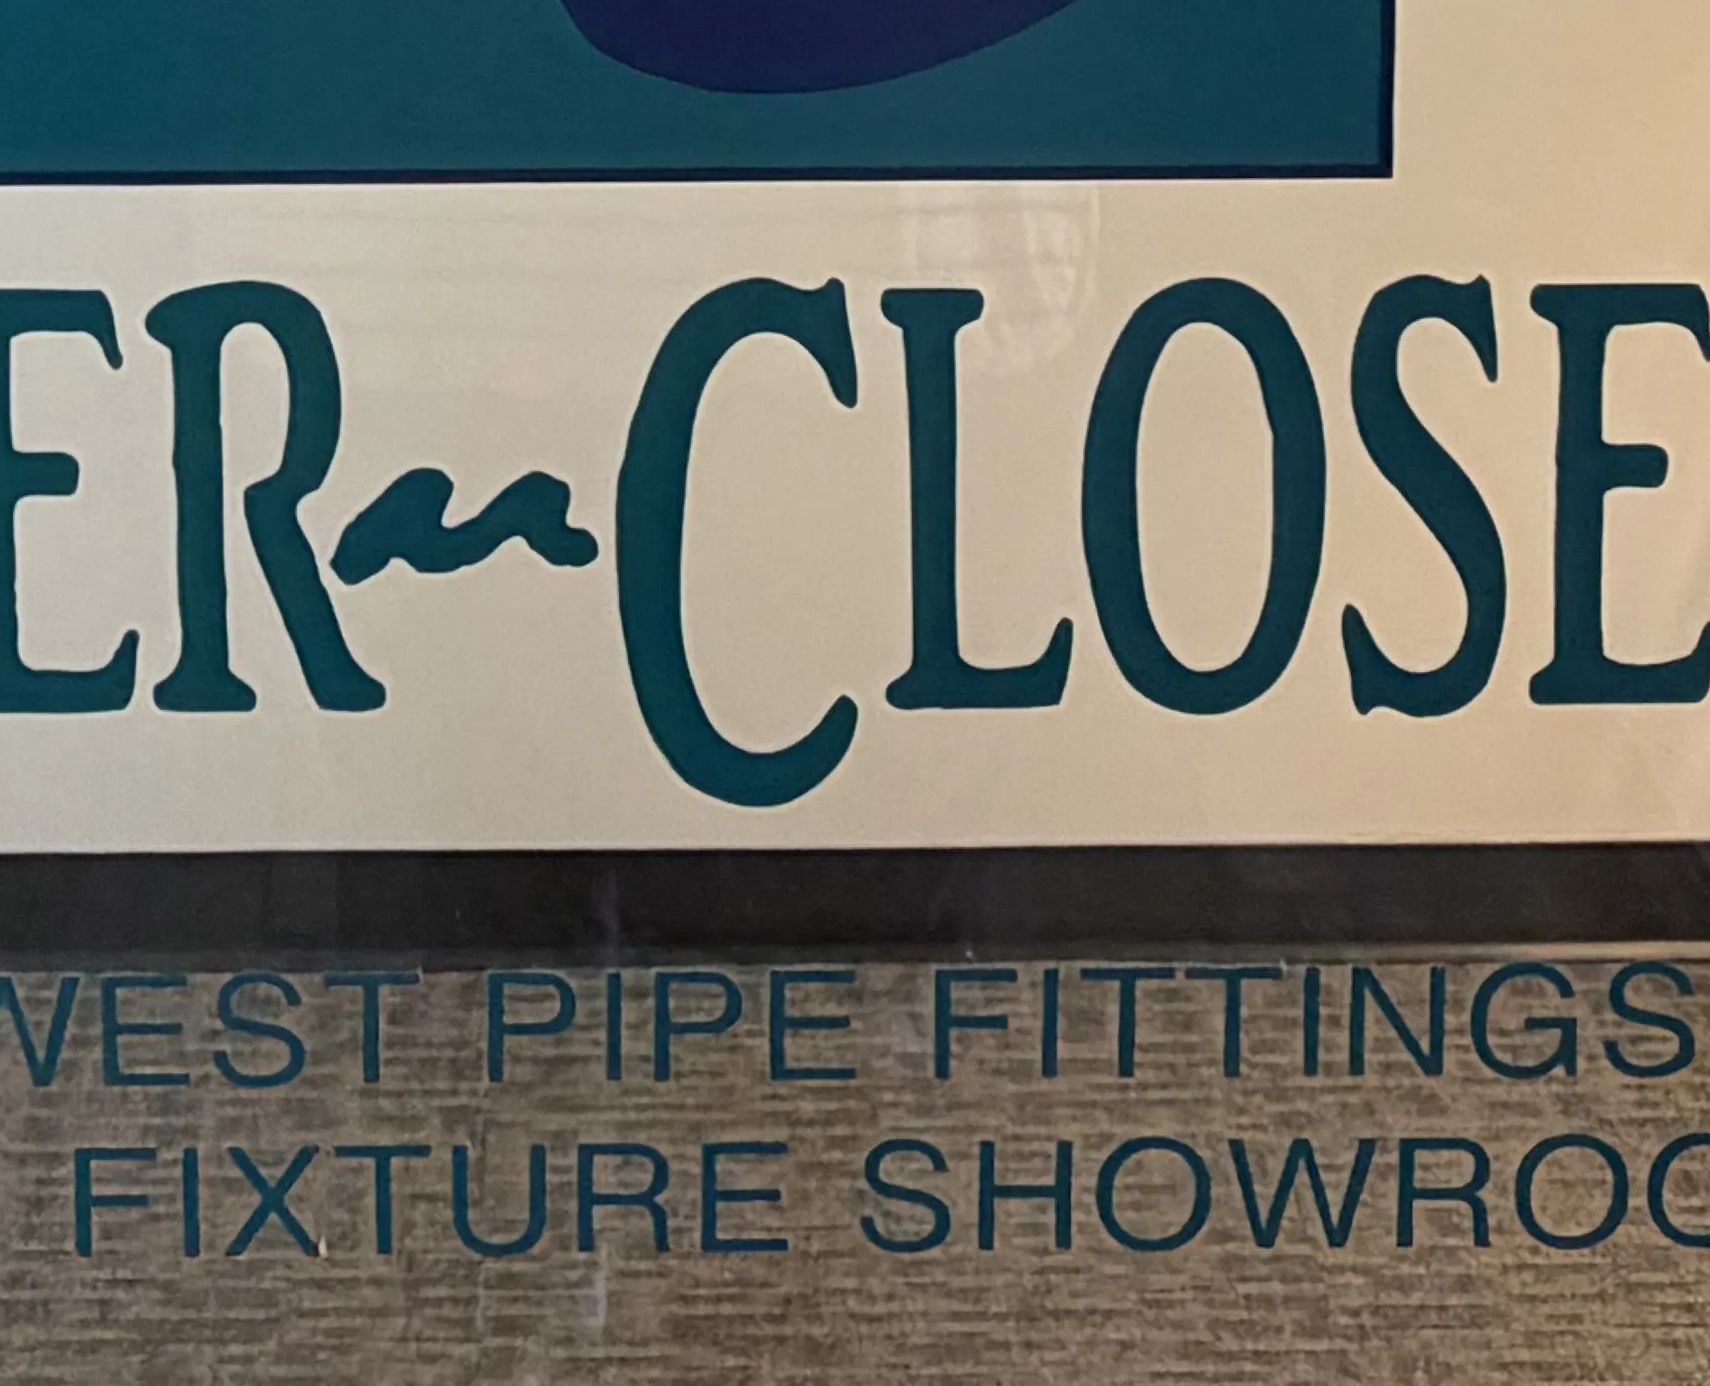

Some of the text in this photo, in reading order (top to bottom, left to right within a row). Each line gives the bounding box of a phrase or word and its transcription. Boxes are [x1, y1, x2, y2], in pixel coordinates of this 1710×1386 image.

[486, 968, 858, 1083] PIPE
[934, 962, 1698, 1080] FITTINGS
[74, 1141, 790, 1258] FIXTURE
